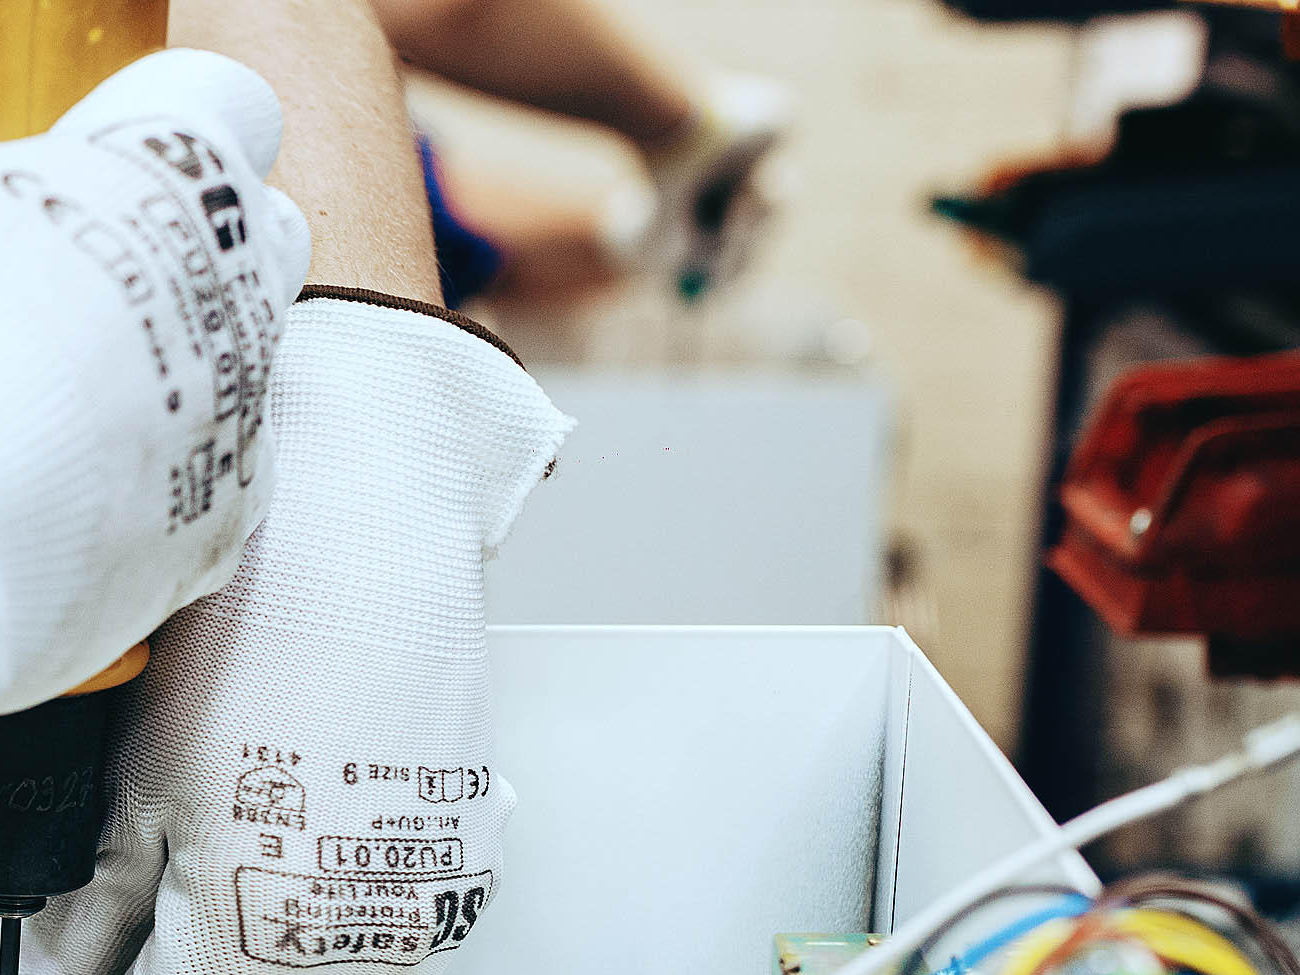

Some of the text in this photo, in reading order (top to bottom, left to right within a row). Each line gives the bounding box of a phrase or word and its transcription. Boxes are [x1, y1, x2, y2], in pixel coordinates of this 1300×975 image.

[143, 131, 248, 252] SG
[343, 762, 411, 785] SIZE 9
[259, 833, 284, 859] E
[336, 843, 454, 868] PU20.01
[284, 898, 421, 923] Protecting
[429, 886, 485, 950] SG
[276, 923, 419, 957] safety
